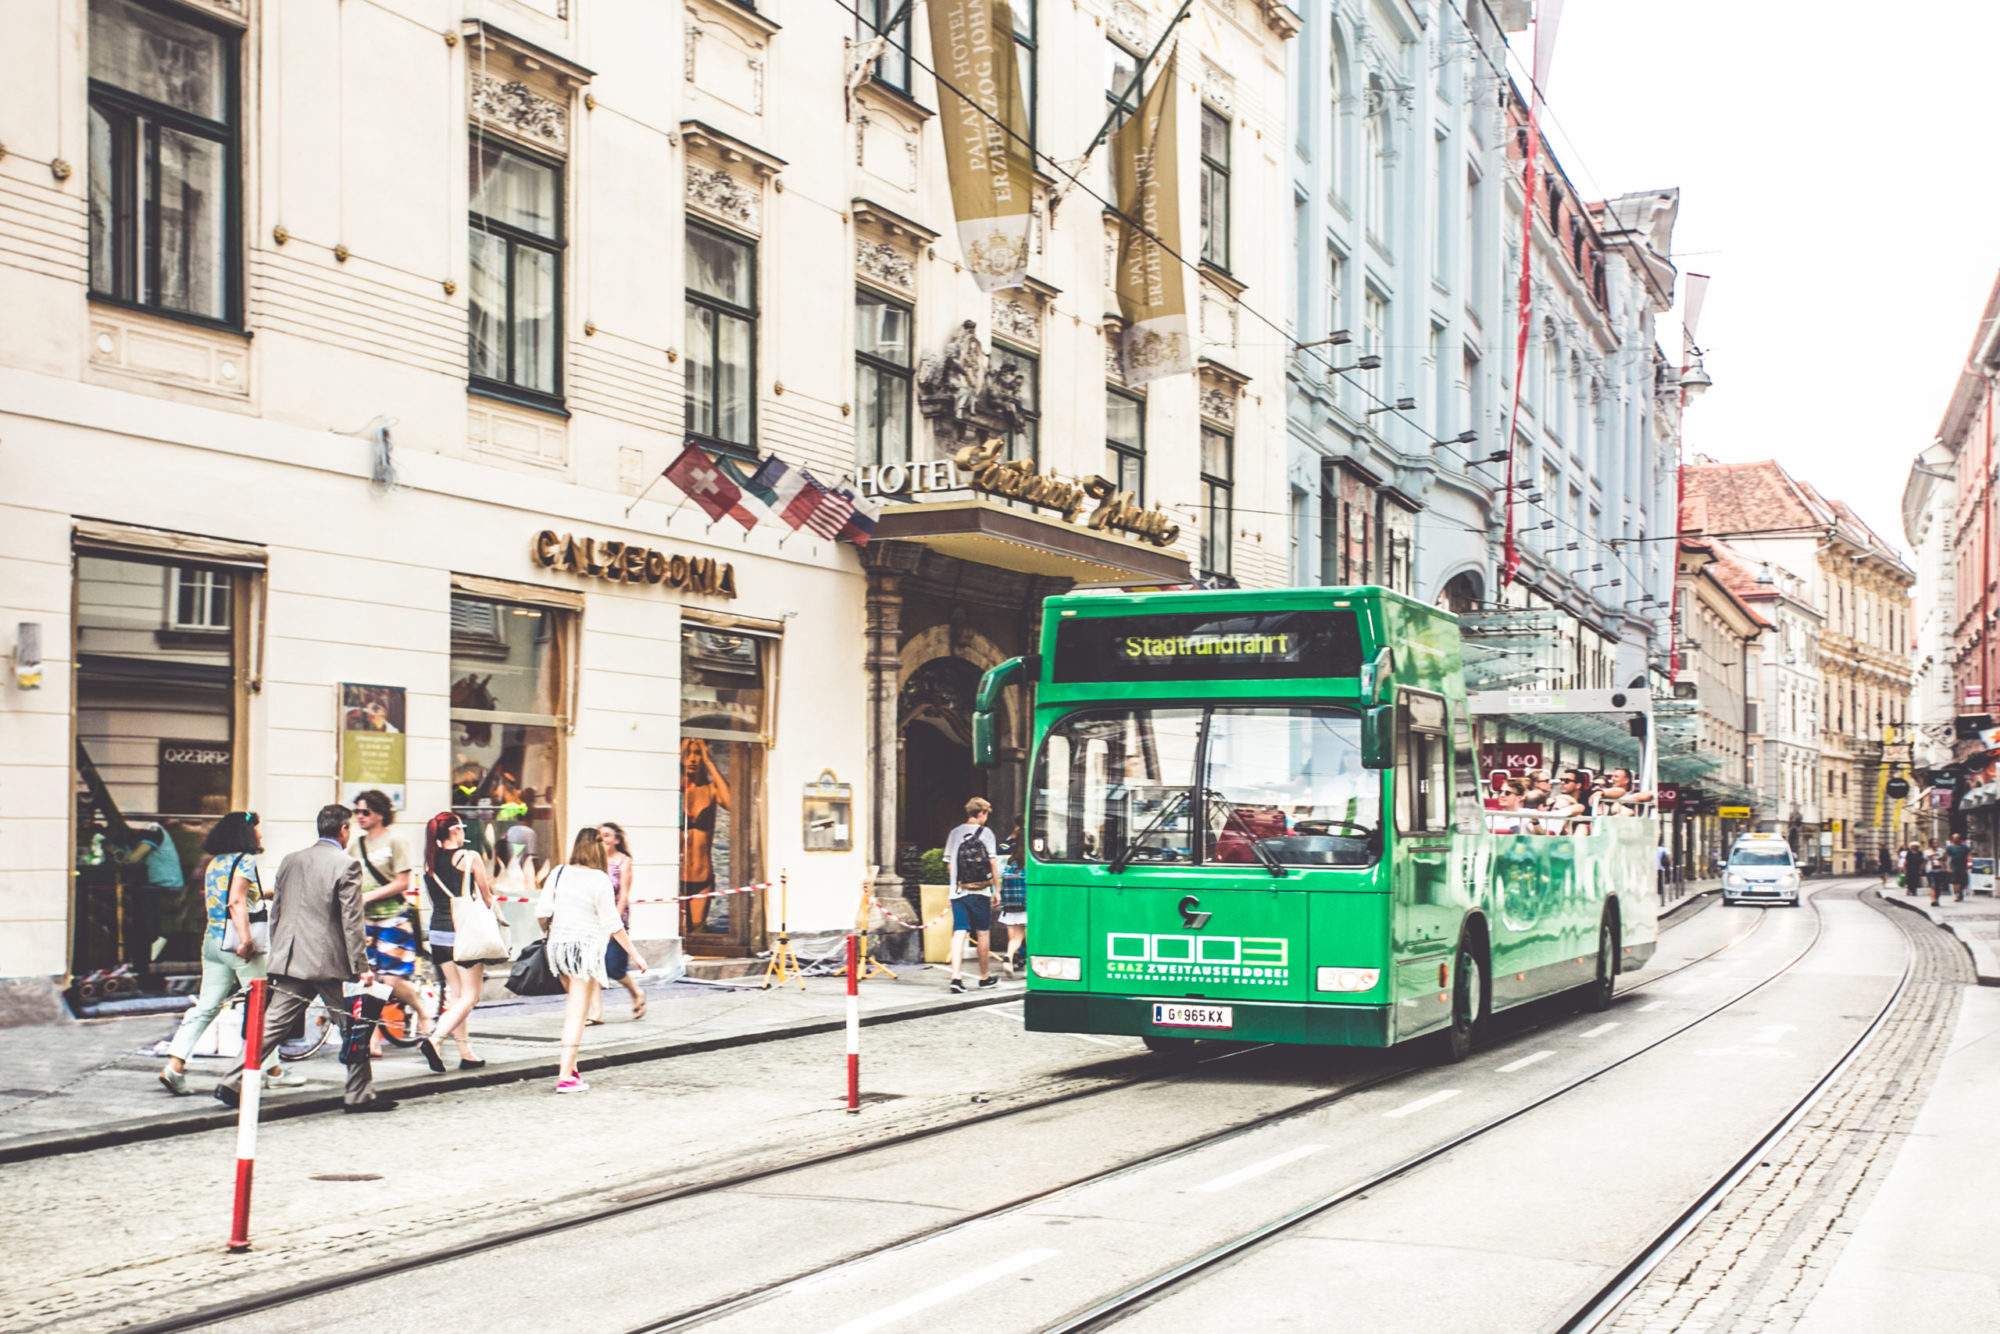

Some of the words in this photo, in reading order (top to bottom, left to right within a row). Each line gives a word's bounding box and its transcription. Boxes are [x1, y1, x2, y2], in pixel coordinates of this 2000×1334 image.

[948, 1, 970, 78] HOTEL
[957, 94, 987, 171] PALAIS
[973, 61, 1012, 202] ERZHERZOG
[856, 460, 969, 495] HOTEL
[531, 530, 737, 599] CALZEDONIA
[1126, 633, 1289, 657] Stadtrundfahrt
[1506, 754, 1538, 768] K&O
[1106, 973, 1229, 984] KULTURHAUPTSTADT
[1233, 978, 1289, 986] EUROPAS
[1107, 962, 1144, 973] GRAZ
[1147, 963, 1289, 978] ZWEITAUSENDDREI
